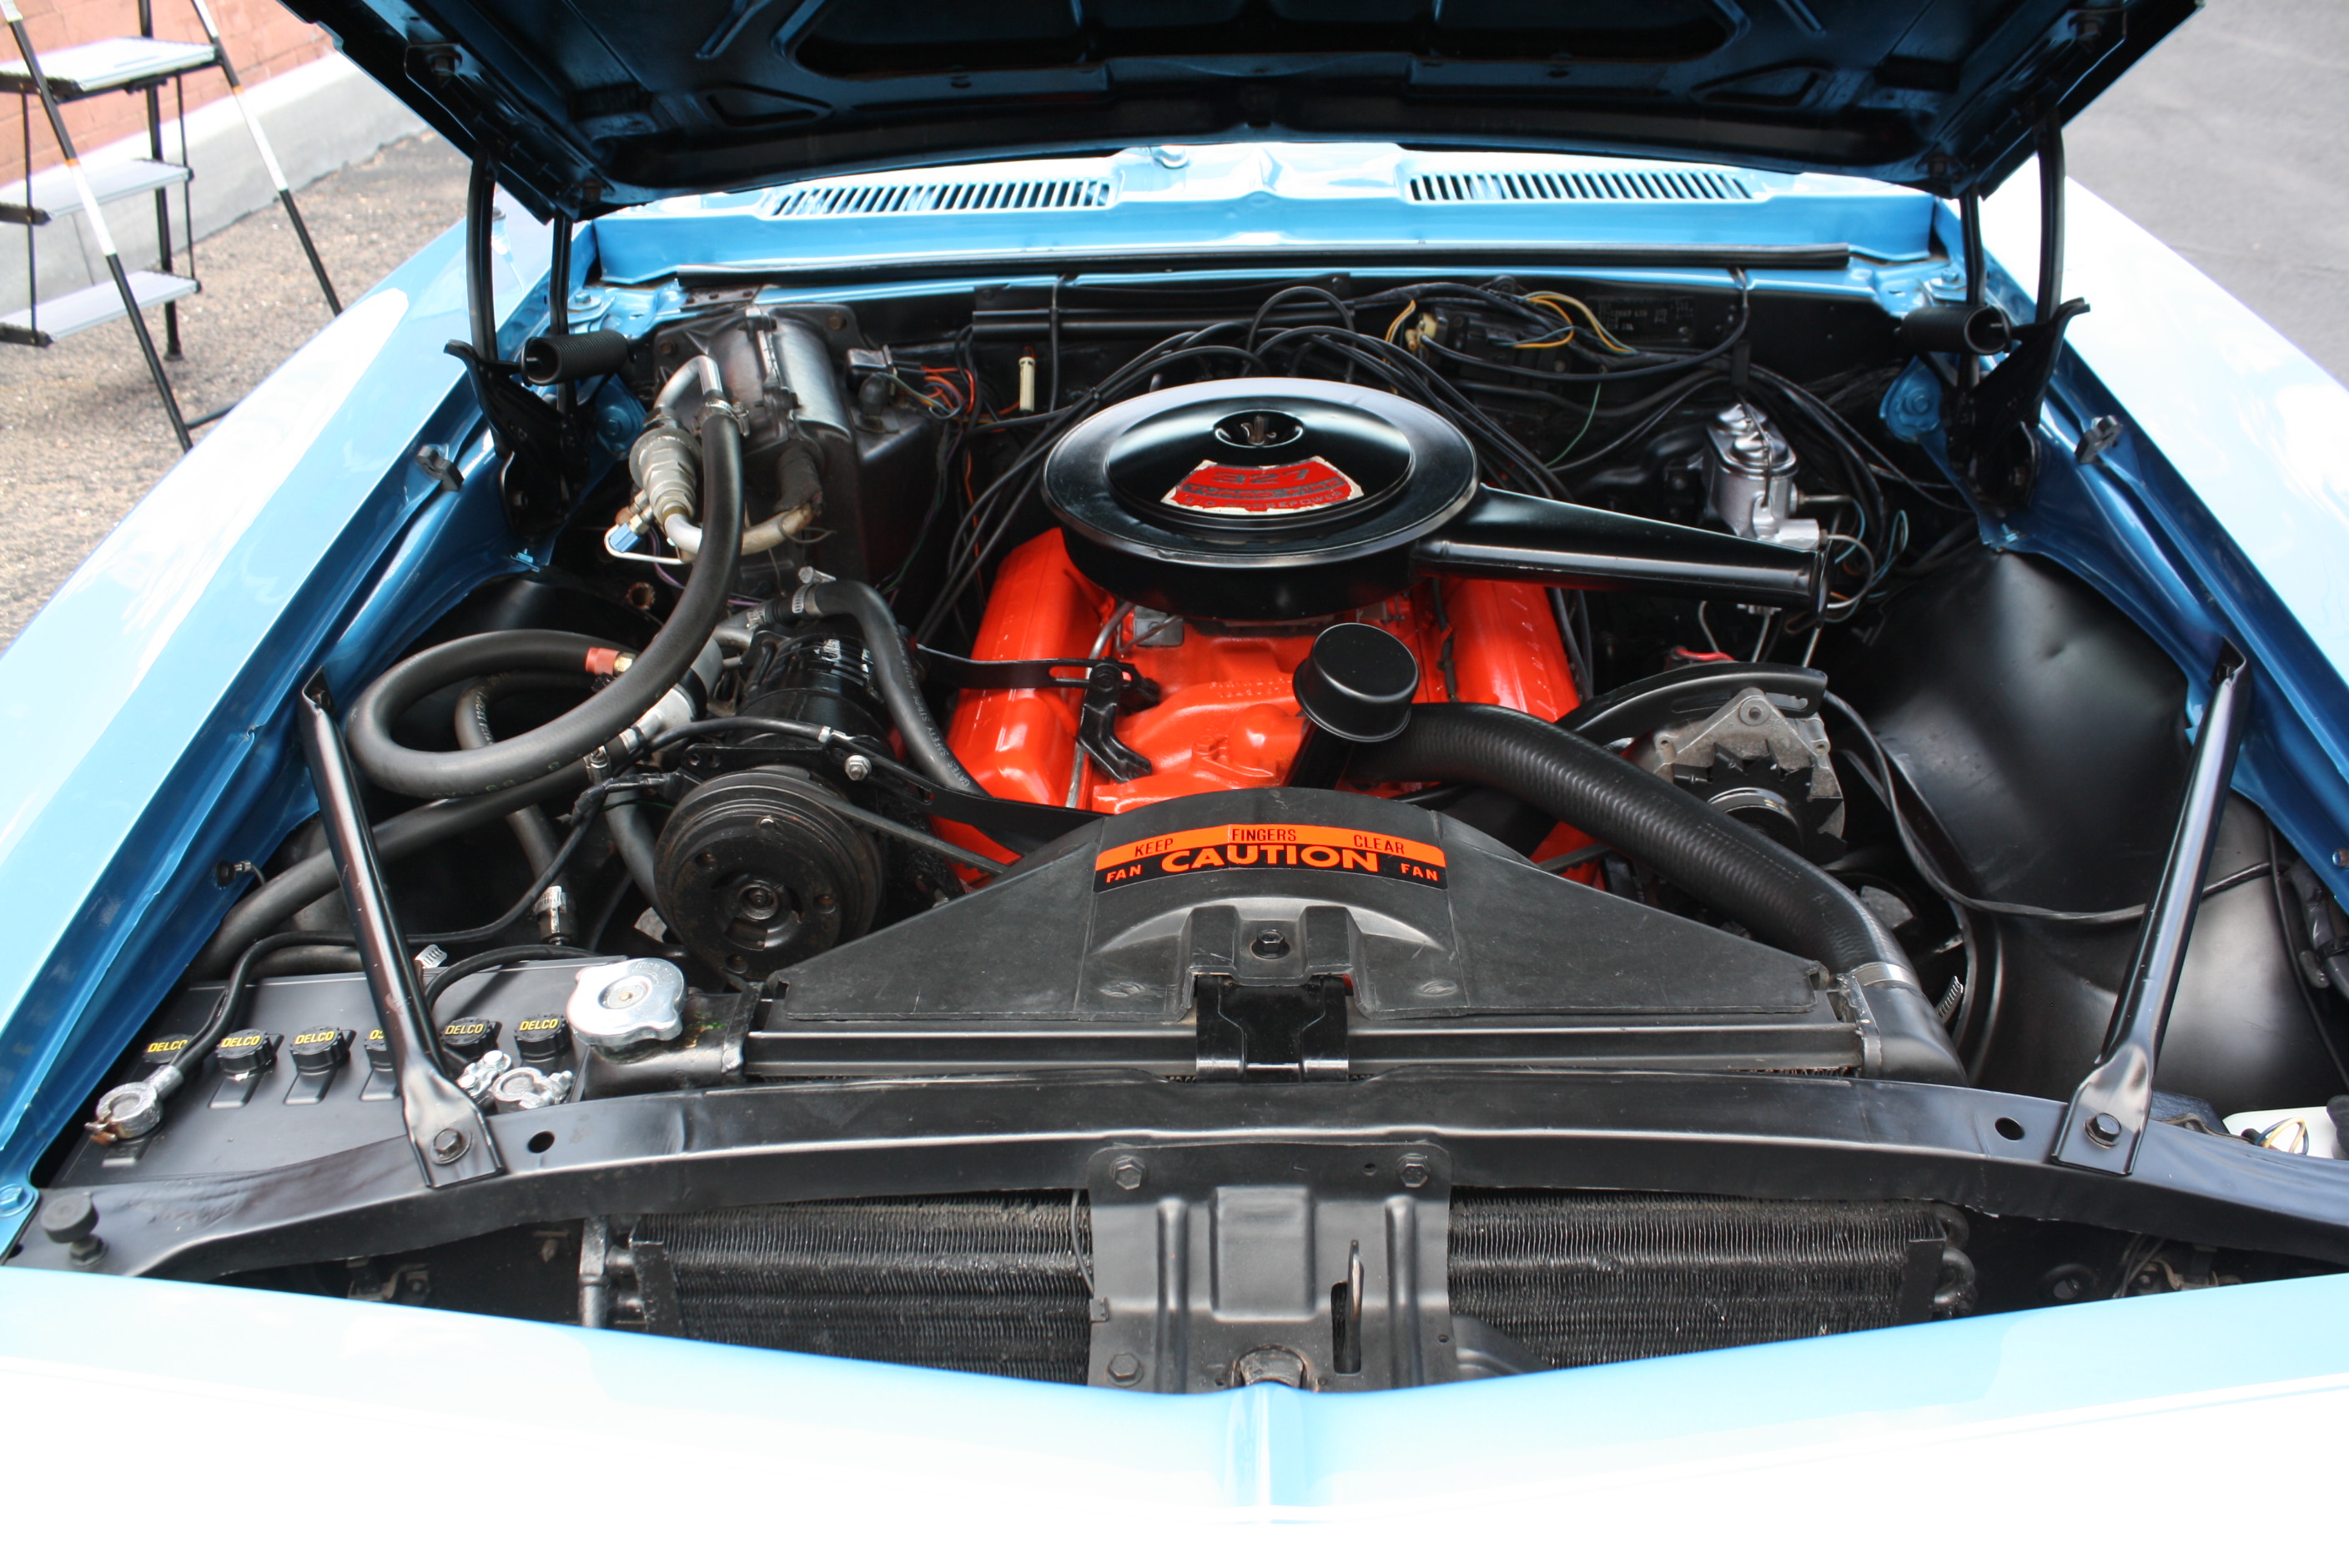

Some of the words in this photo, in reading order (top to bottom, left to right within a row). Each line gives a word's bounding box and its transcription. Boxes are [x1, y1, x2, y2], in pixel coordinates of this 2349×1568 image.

[1213, 468, 1310, 485] 327
[1225, 490, 1343, 509] HORSEPOWER
[927, 726, 949, 756] SAFETY
[947, 760, 971, 787] GATES
[1134, 837, 1173, 857] KEEP
[1232, 828, 1296, 842] FINGERS
[1353, 834, 1405, 855] CLEAR
[1105, 864, 1141, 883] FAN
[1161, 844, 1379, 873] CAUTION
[1400, 862, 1439, 882] FAN
[444, 1023, 485, 1036] DELCO
[519, 1018, 560, 1032] DELCO
[220, 1034, 262, 1048] DELCO
[294, 1031, 335, 1045] DELCO
